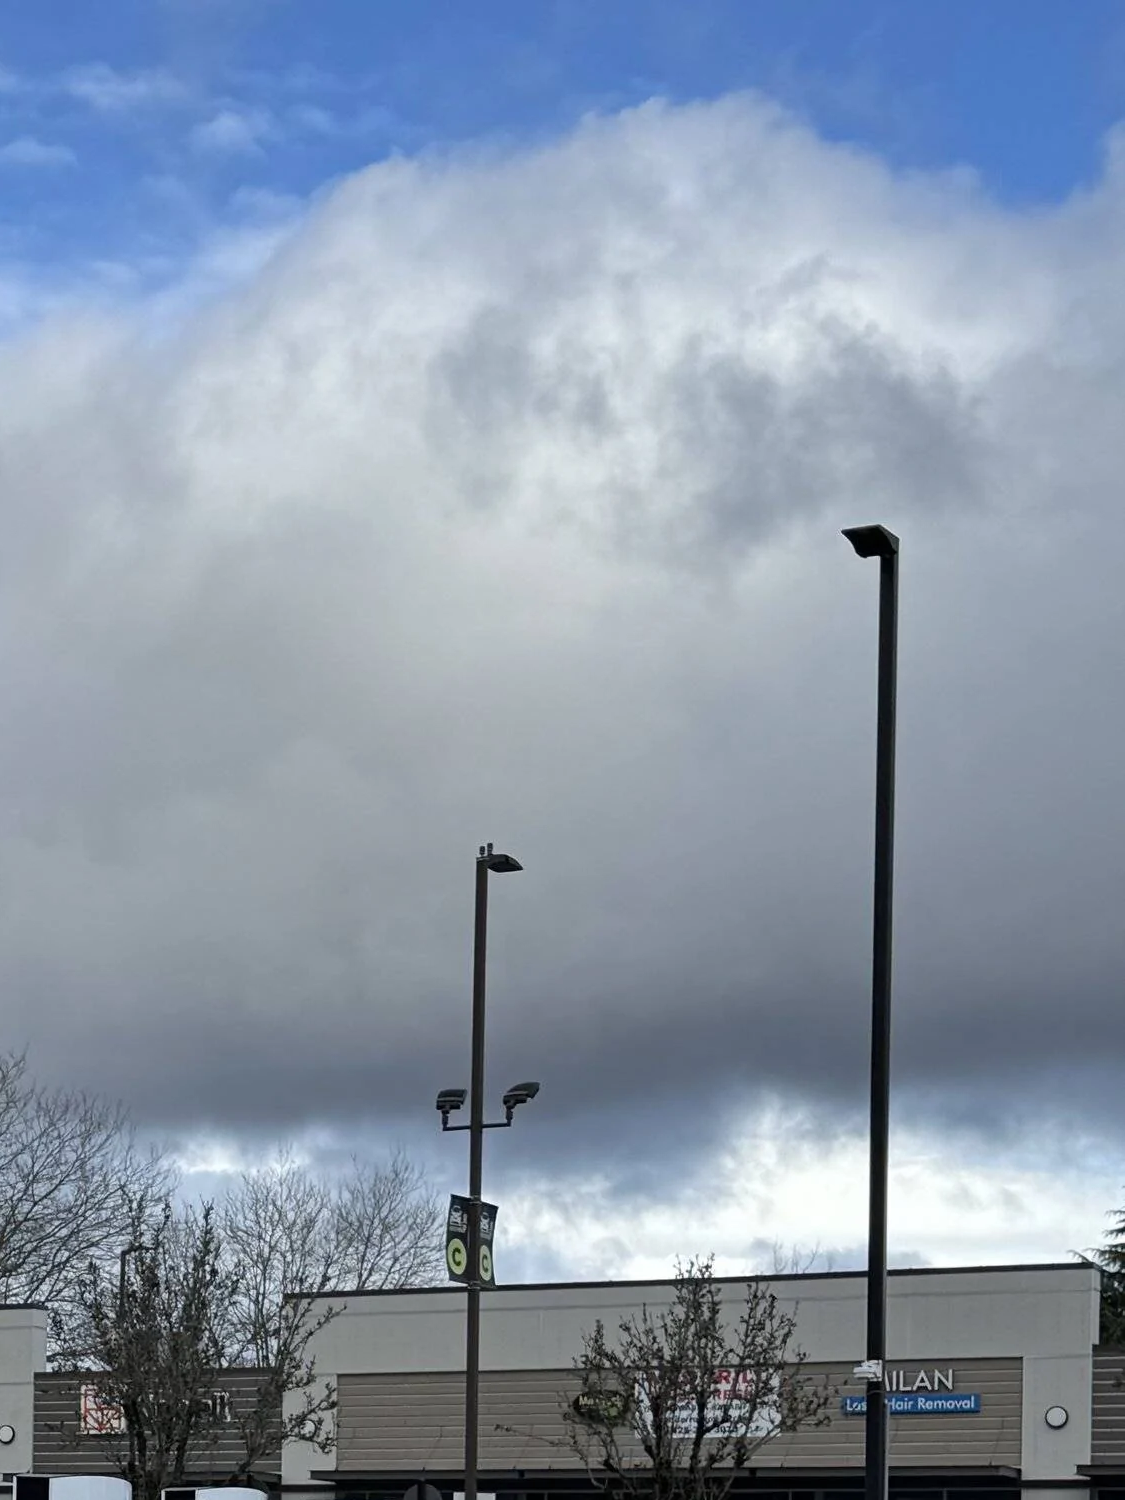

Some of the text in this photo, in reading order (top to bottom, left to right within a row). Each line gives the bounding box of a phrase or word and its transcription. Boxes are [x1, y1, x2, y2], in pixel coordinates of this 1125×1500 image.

[452, 1247, 462, 1267] C
[846, 1395, 974, 1411] Las Hair Removal
